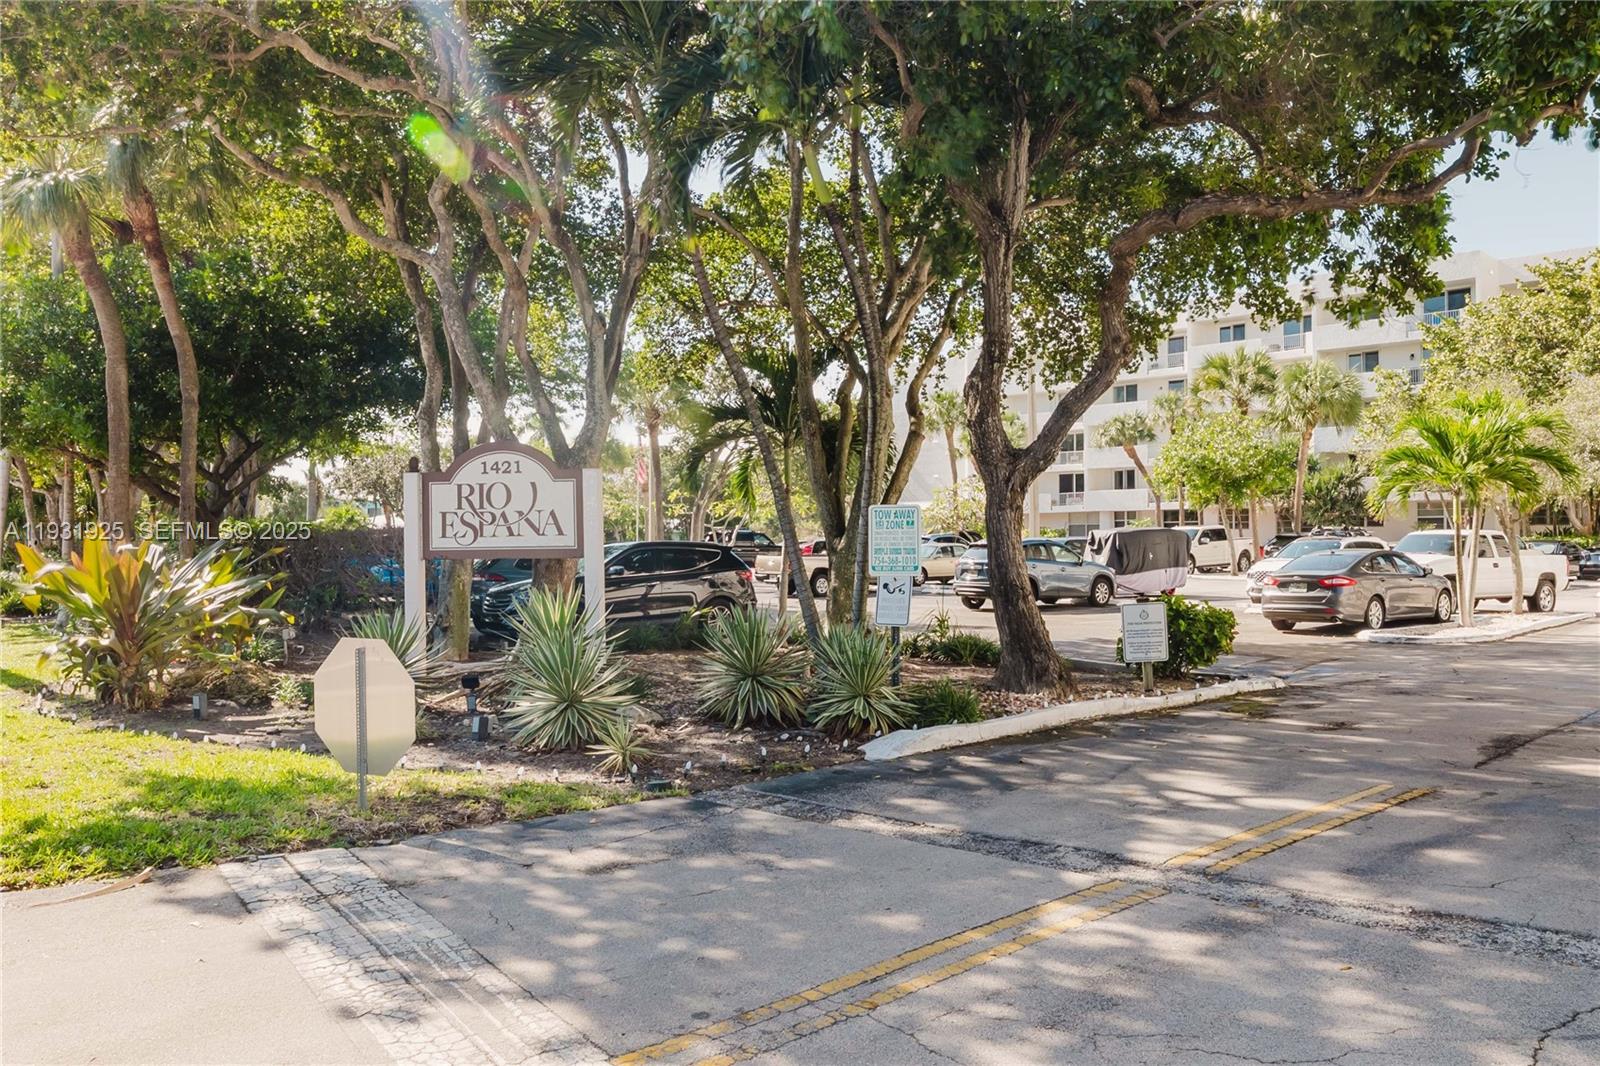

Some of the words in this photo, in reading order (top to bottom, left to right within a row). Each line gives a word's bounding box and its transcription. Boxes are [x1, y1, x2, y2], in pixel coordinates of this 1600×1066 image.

[480, 460, 522, 475] 1421
[455, 481, 512, 512] RIO
[874, 509, 892, 519] TOW
[894, 509, 916, 519] AWAY
[439, 508, 567, 546] ESPANA
[885, 520, 905, 529] ZONE
